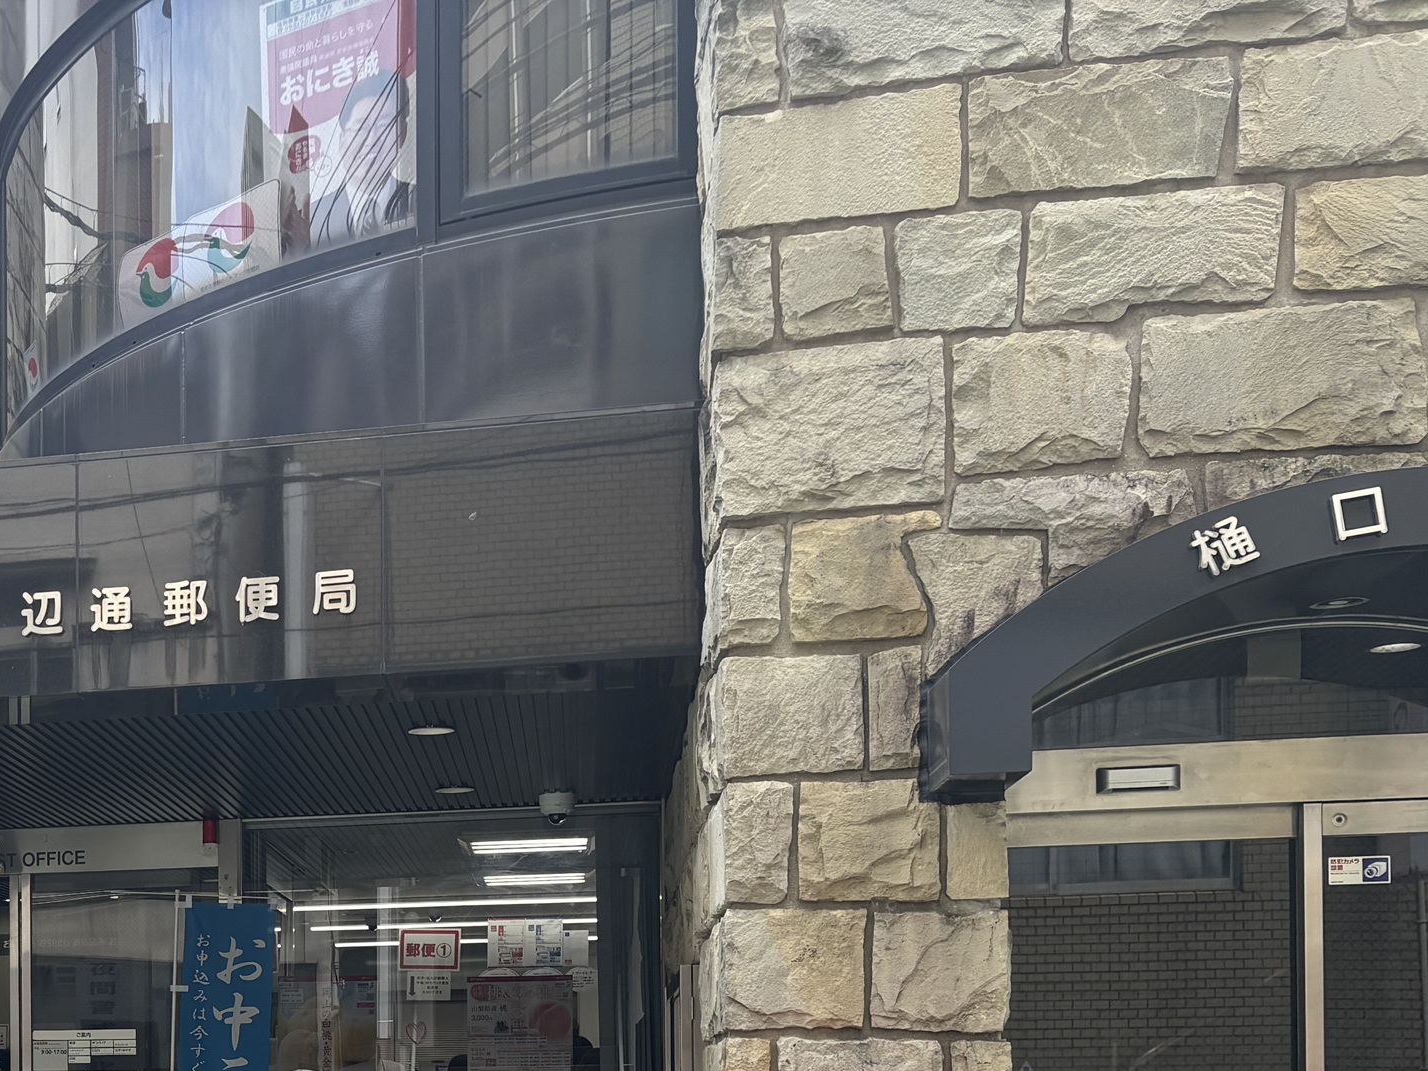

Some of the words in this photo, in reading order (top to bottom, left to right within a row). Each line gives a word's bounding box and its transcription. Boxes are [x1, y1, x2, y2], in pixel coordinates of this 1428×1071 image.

[280, 50, 380, 106] おにき誠
[1190, 486, 1389, 576] 樋口
[22, 850, 86, 867] OFFICE
